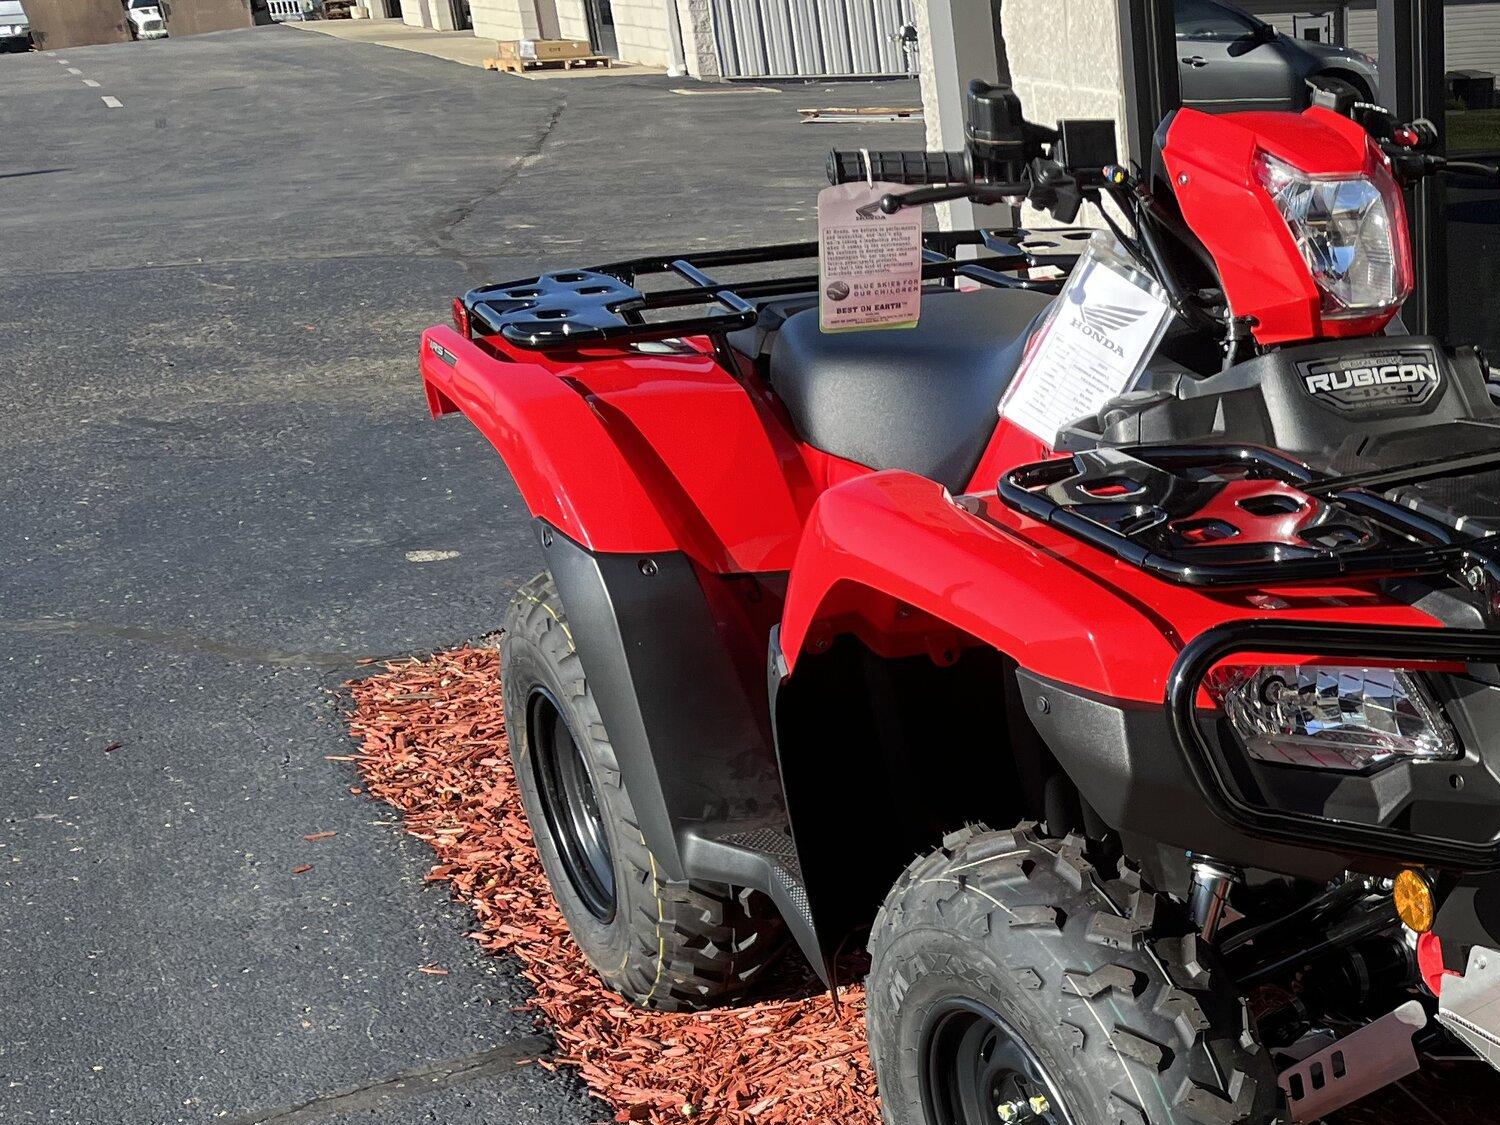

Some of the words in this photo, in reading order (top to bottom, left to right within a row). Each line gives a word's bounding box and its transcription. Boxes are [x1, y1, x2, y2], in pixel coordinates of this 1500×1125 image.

[875, 287, 919, 296] CHILDREN
[836, 305, 858, 314] BEST
[1069, 317, 1124, 358] HONDA
[1305, 363, 1437, 394] RUBICON
